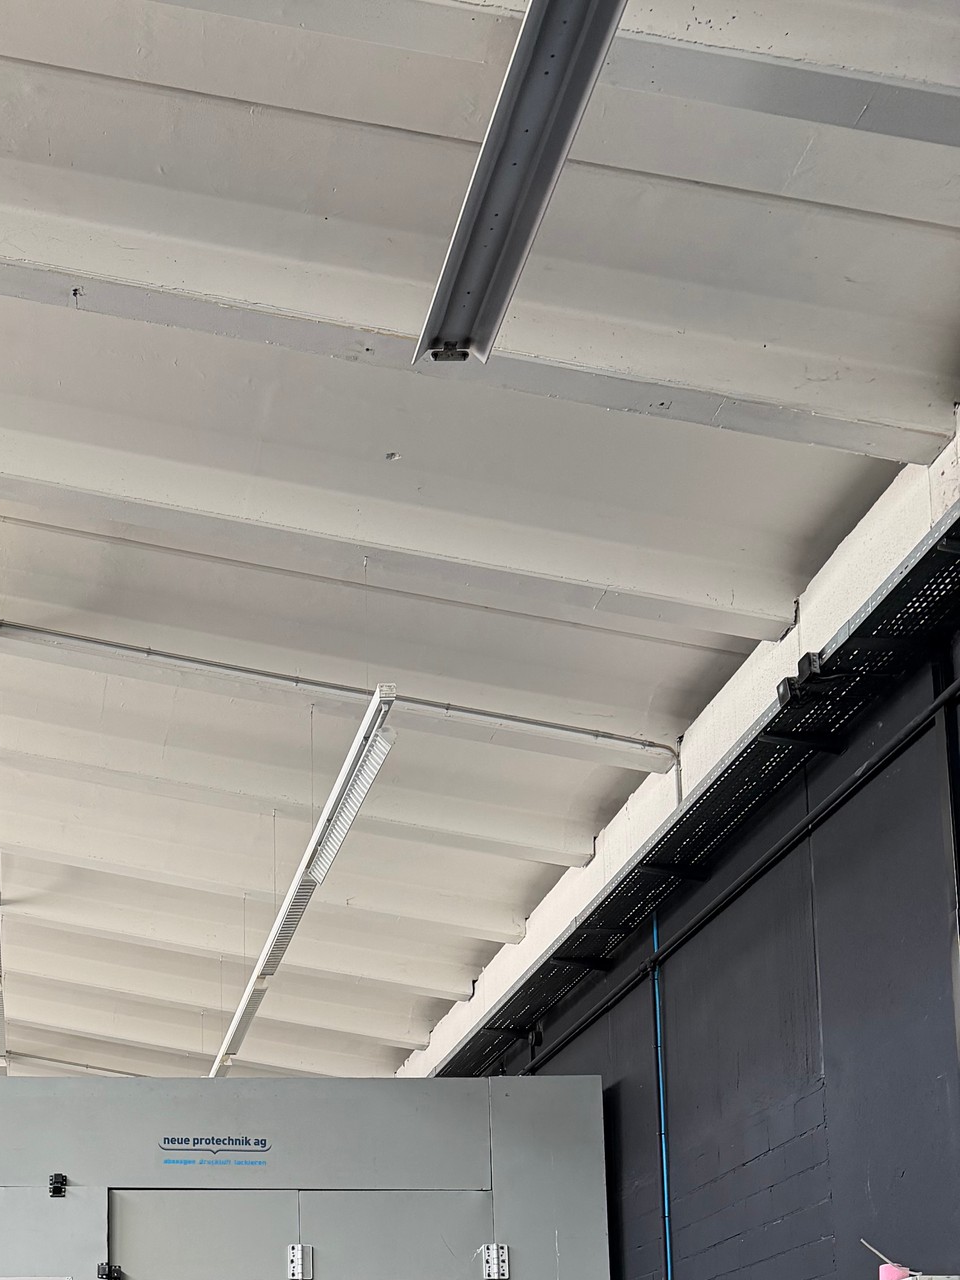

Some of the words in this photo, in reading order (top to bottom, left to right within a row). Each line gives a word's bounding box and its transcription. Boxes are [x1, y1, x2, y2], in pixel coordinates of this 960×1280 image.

[163, 1136, 190, 1145] neue
[192, 1136, 251, 1147] protechnik
[253, 1138, 267, 1148] ag
